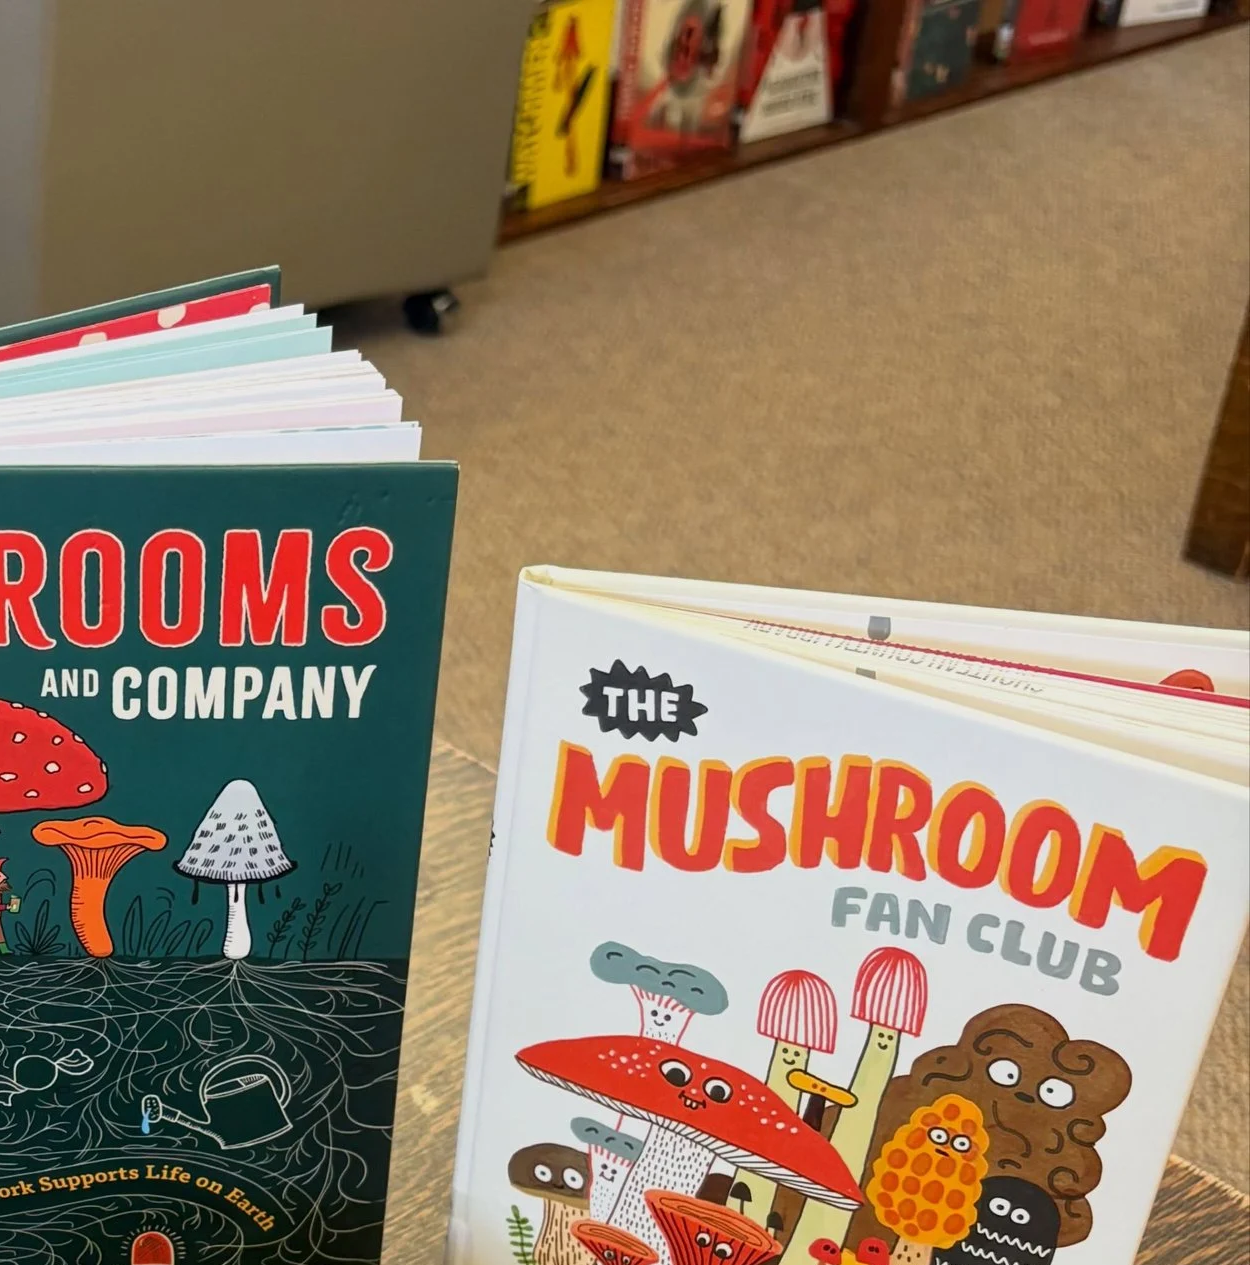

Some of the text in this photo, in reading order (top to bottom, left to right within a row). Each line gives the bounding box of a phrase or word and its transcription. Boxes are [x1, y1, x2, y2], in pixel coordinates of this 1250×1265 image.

[40, 664, 378, 722] AND COMPANY
[602, 687, 680, 724] THE
[546, 740, 1208, 963] MUSHROOM
[831, 886, 1122, 997] FAN CLUB
[38, 1167, 139, 1194] Supports
[145, 1164, 191, 1185] Life
[195, 1175, 224, 1196] on
[224, 1186, 275, 1233] Earth
